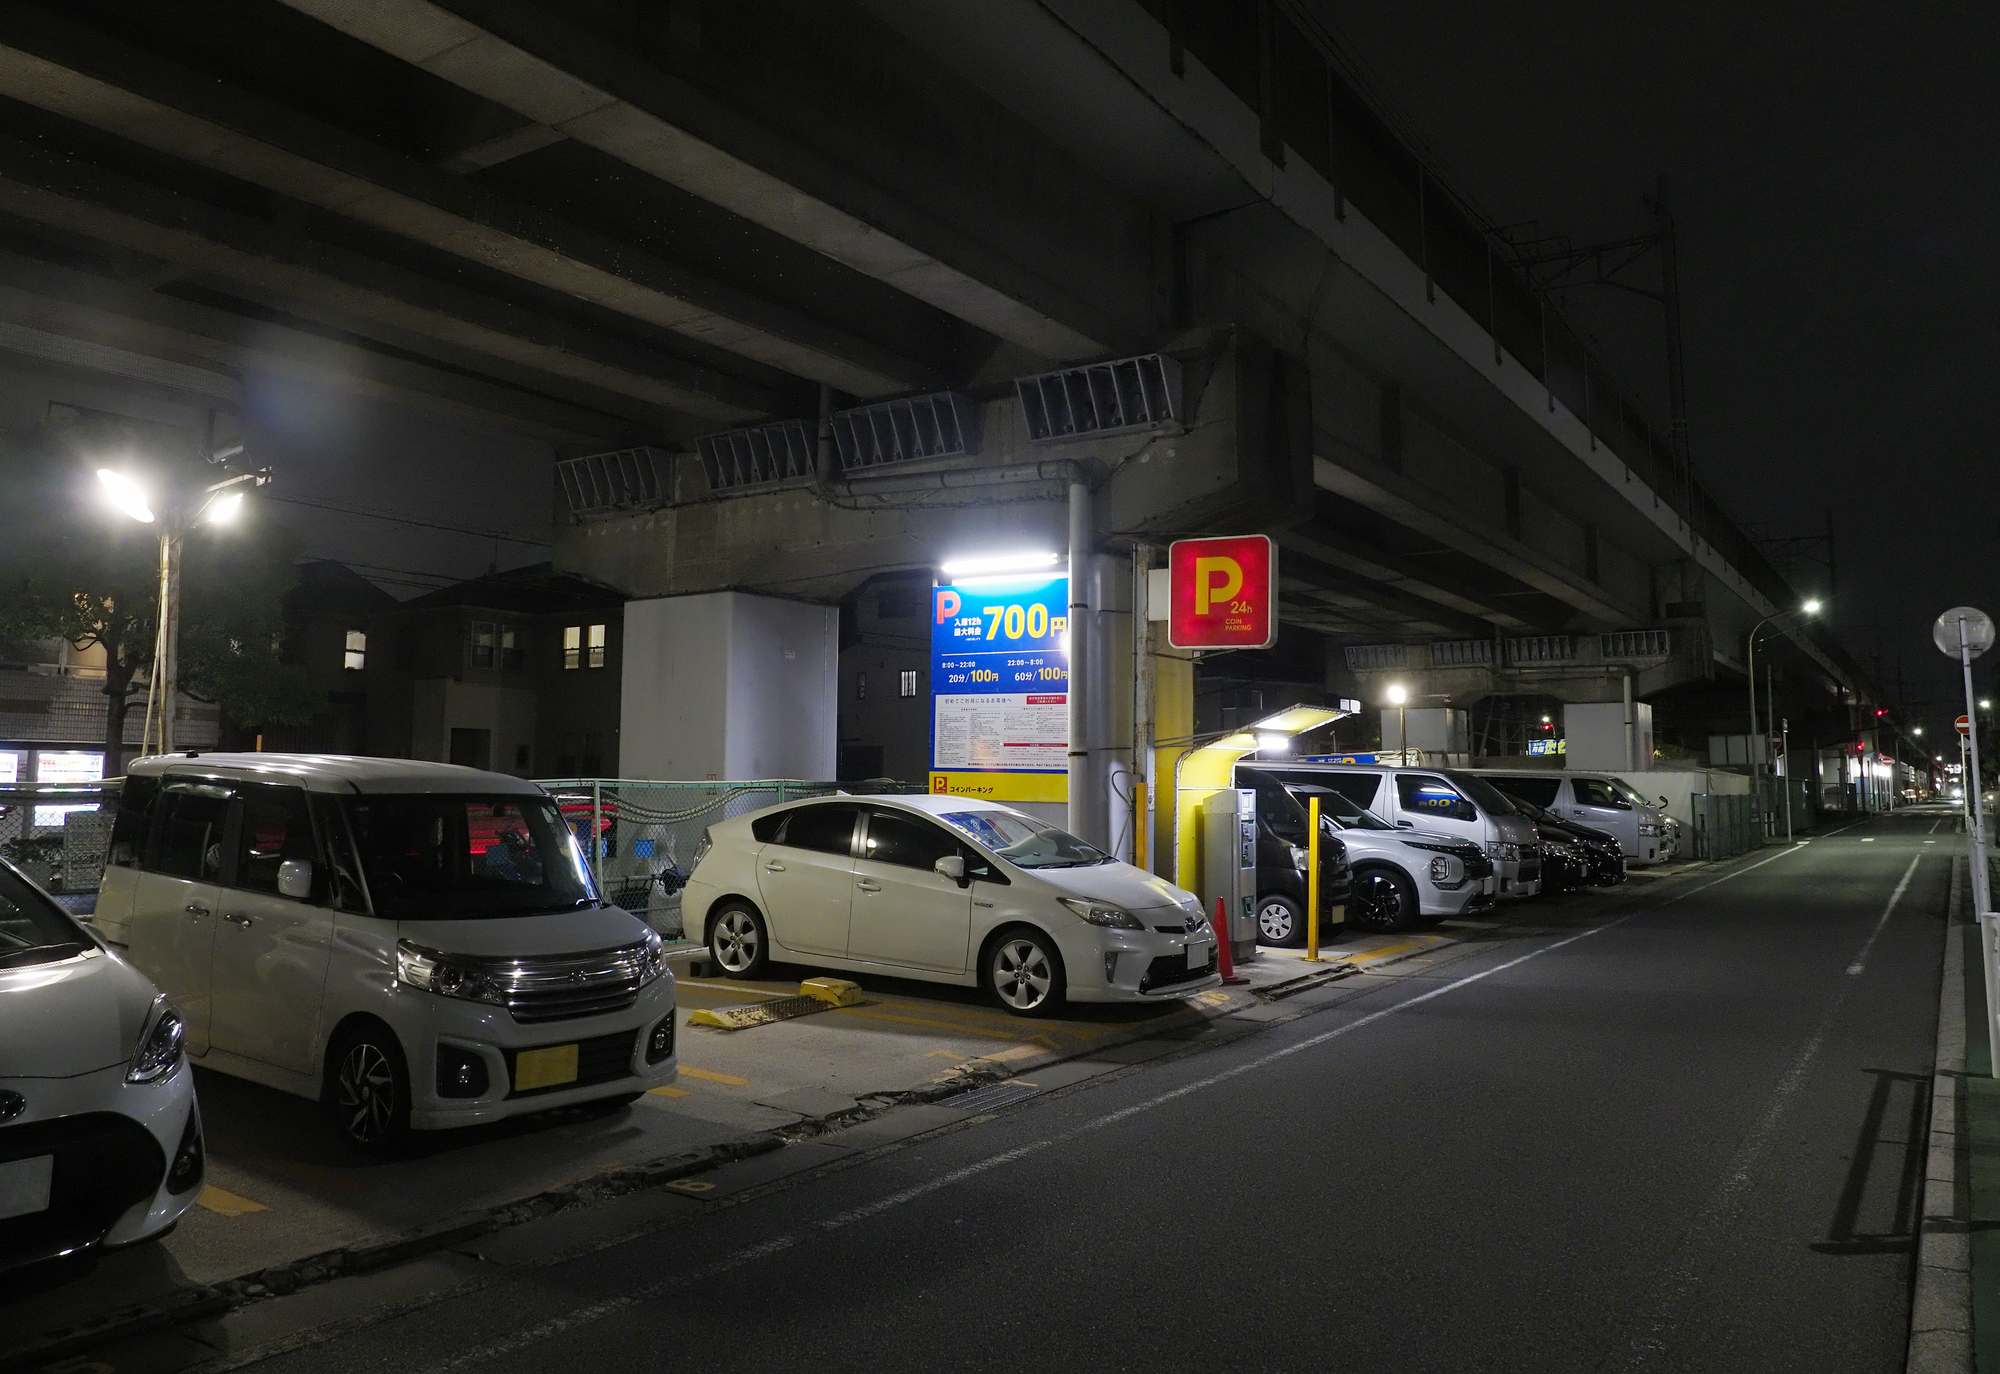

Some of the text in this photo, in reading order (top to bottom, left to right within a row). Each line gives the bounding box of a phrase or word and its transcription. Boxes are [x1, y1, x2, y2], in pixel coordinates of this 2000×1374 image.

[1195, 556, 1243, 615] P
[936, 591, 961, 625] P
[1230, 601, 1253, 614] 24h
[953, 627, 982, 637] 最大料金
[936, 778, 945, 789] P
[950, 786, 993, 794] コインパーキング
